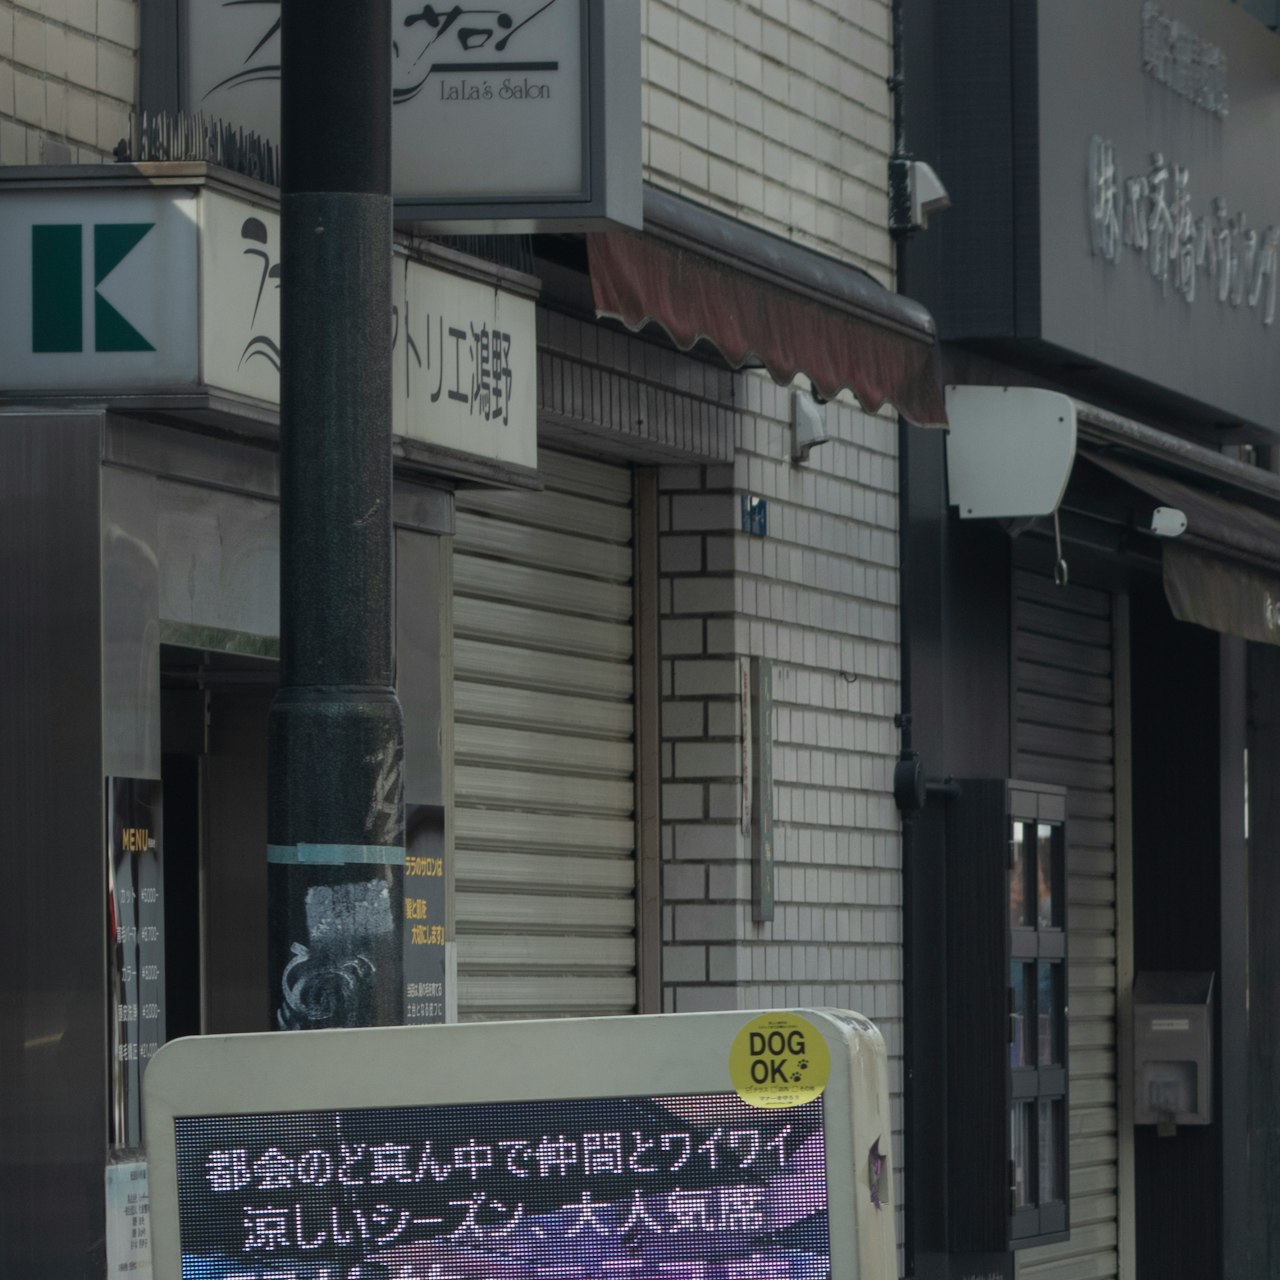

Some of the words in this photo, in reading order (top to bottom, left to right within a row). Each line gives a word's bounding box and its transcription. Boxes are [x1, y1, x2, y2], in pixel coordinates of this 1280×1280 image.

[440, 80, 493, 101] LaLa's
[498, 78, 550, 100] Salon
[392, 303, 515, 427] トリエ鴻野
[122, 828, 149, 852] MENU
[749, 1030, 805, 1056] DOG
[751, 1059, 789, 1084] OK
[205, 1124, 797, 1194] 都会のど真ん中で仲間とワイワイ
[242, 1184, 766, 1254] 涼しいシーズン、大人気席
